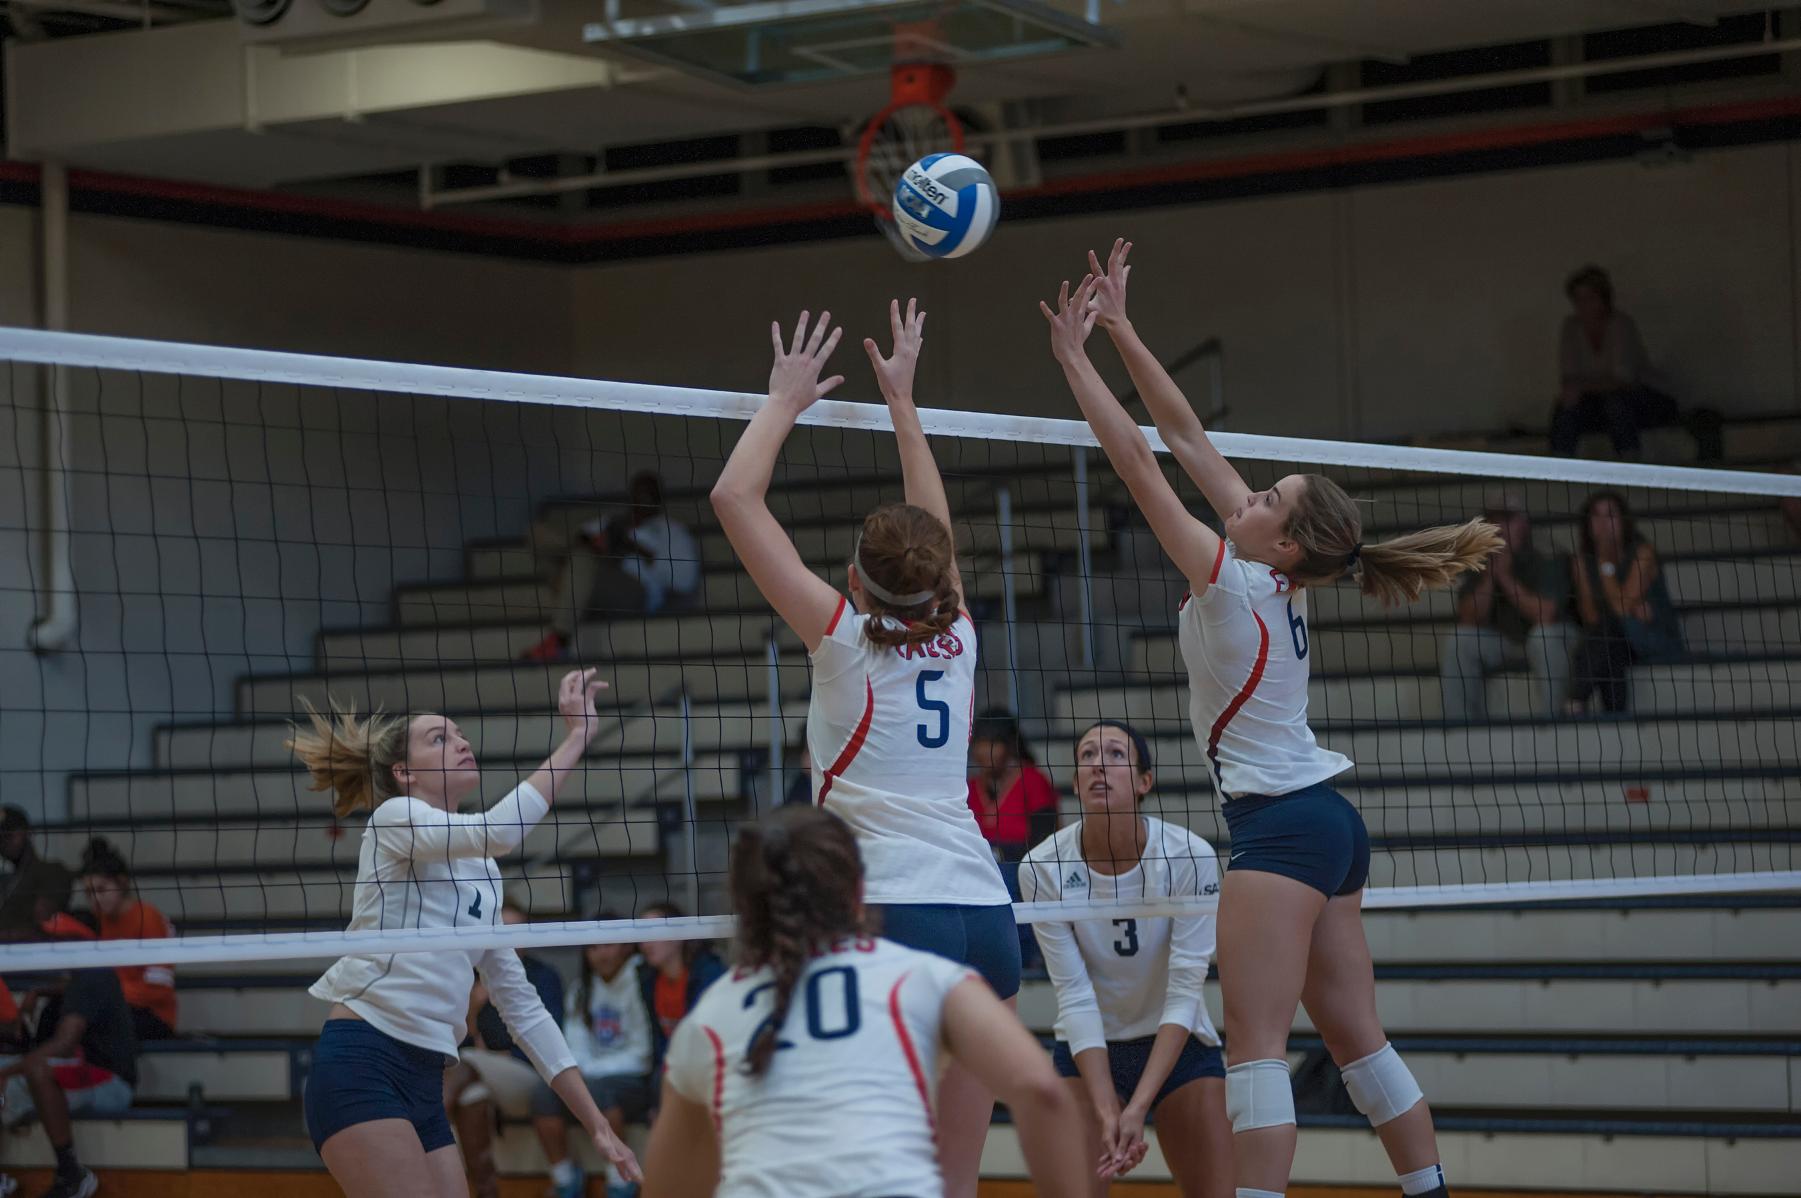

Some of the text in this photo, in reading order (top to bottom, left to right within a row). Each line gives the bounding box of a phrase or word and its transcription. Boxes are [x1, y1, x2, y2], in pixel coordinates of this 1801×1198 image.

[1287, 596, 1308, 660] 6
[916, 670, 950, 749] 5
[1112, 918, 1140, 957] 3
[741, 964, 862, 1054] 20
